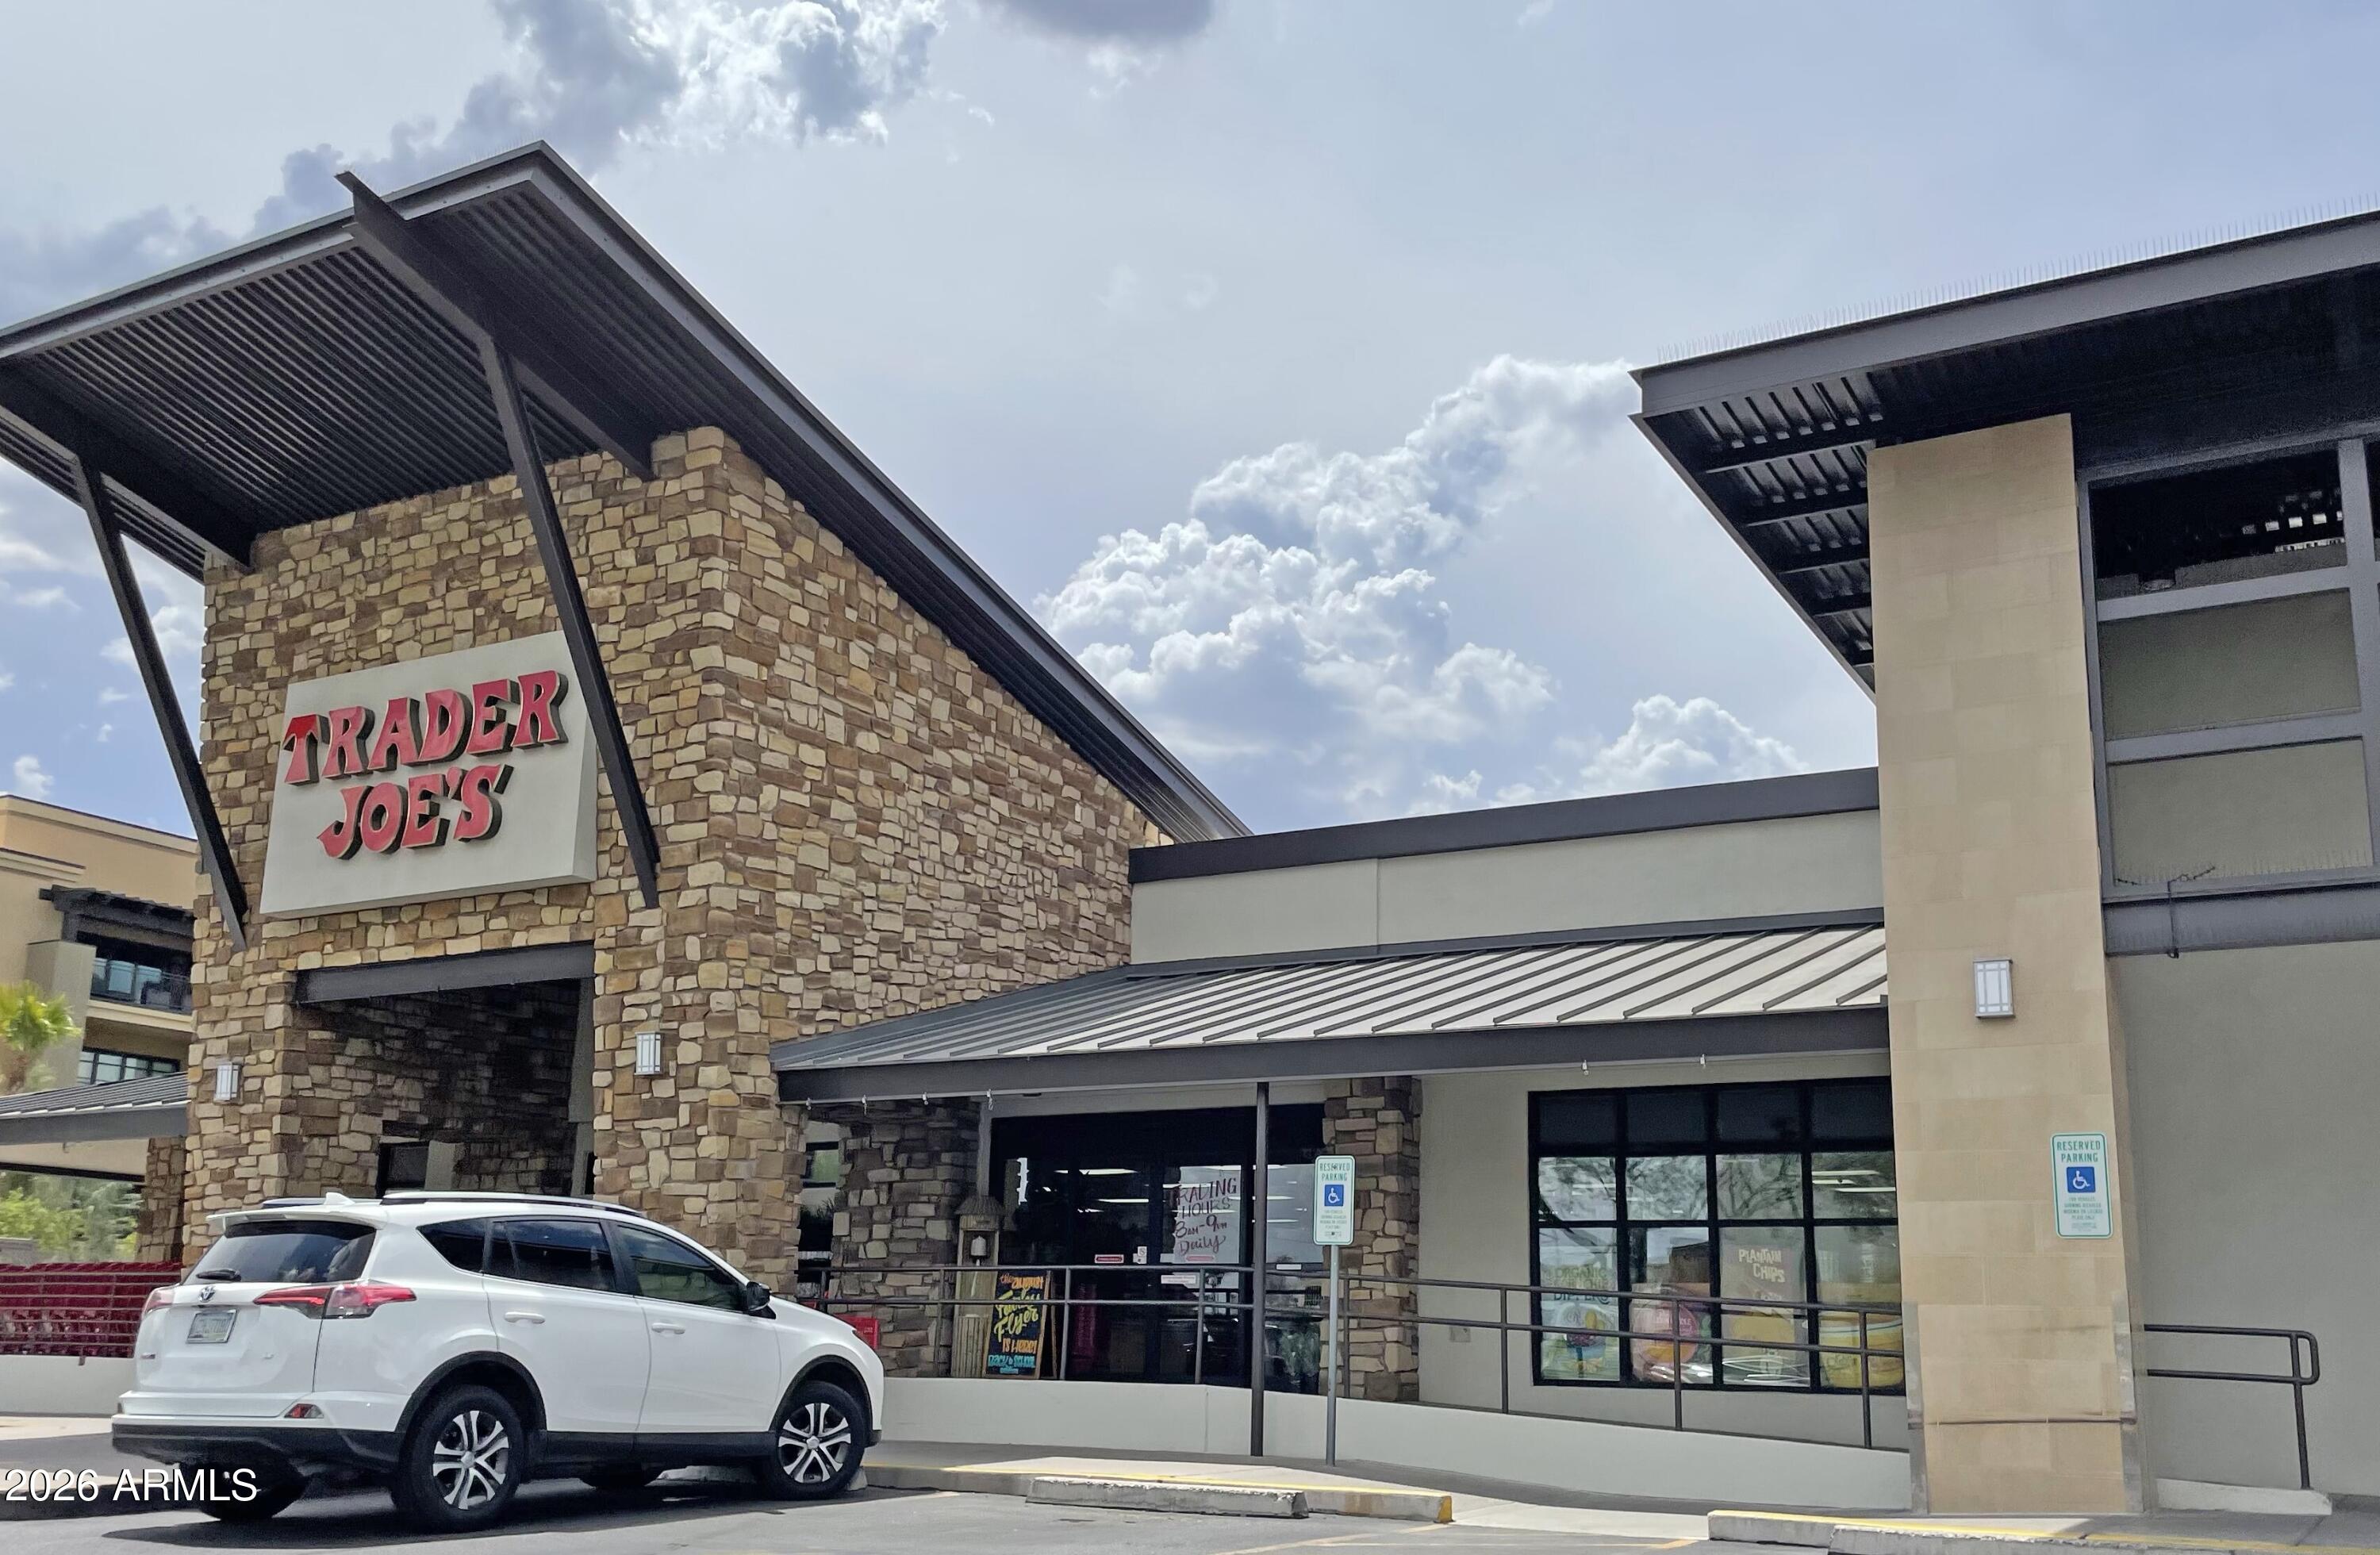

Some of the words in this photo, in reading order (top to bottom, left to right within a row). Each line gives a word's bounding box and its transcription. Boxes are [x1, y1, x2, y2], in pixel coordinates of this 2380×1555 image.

[282, 670, 567, 785] TRADER
[317, 764, 513, 860] JOE'S
[2056, 1140, 2101, 1150] RESERVED
[2061, 1153, 2098, 1163] PARKING
[1319, 1162, 1350, 1172] RESERVED
[1321, 1173, 1348, 1181] PARKING
[1180, 1235, 1226, 1255] Daily
[1738, 1249, 1782, 1265] PLANTAIN
[1752, 1263, 1785, 1283] CHIPS
